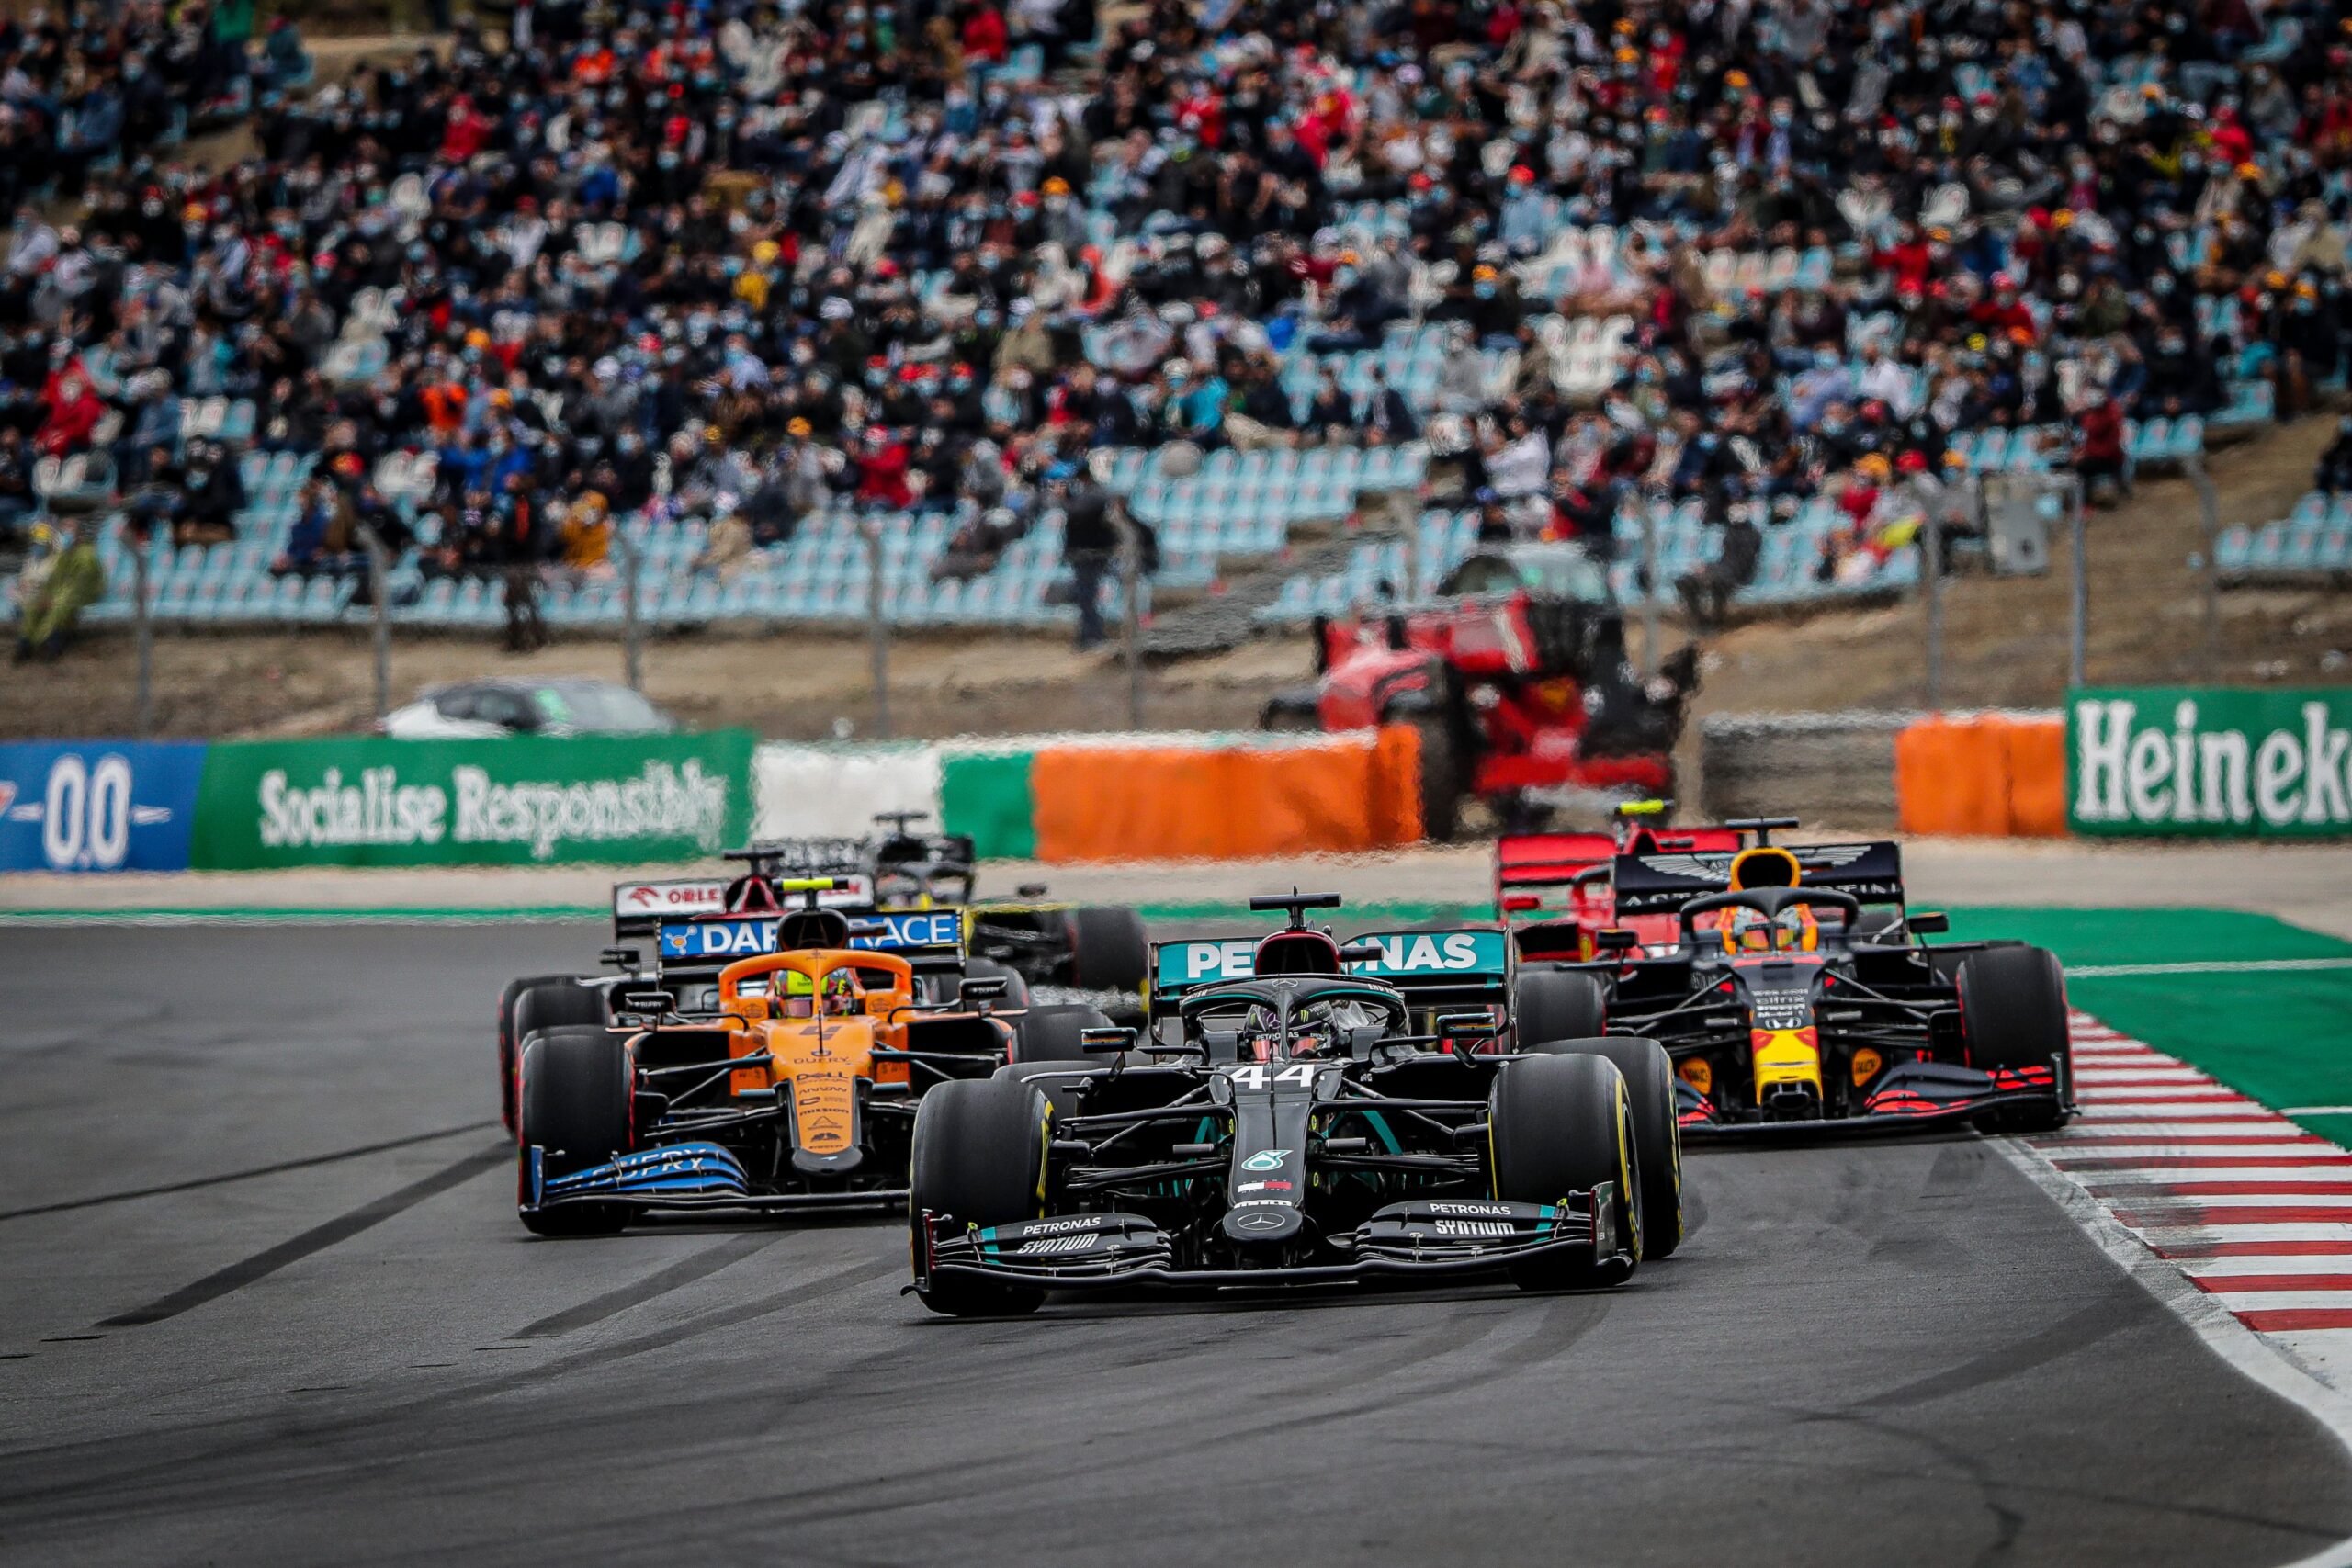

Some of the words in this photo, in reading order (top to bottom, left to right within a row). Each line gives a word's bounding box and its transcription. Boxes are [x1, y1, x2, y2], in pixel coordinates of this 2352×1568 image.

[2074, 698, 2352, 826] Heinek
[260, 767, 447, 846] Socialise
[668, 888, 720, 903] ORLE
[1187, 933, 1476, 978] PENAS
[1229, 1064, 1315, 1089] 44
[1430, 1203, 1511, 1215] PETRONAS
[1023, 1217, 1102, 1235] PETRONAS
